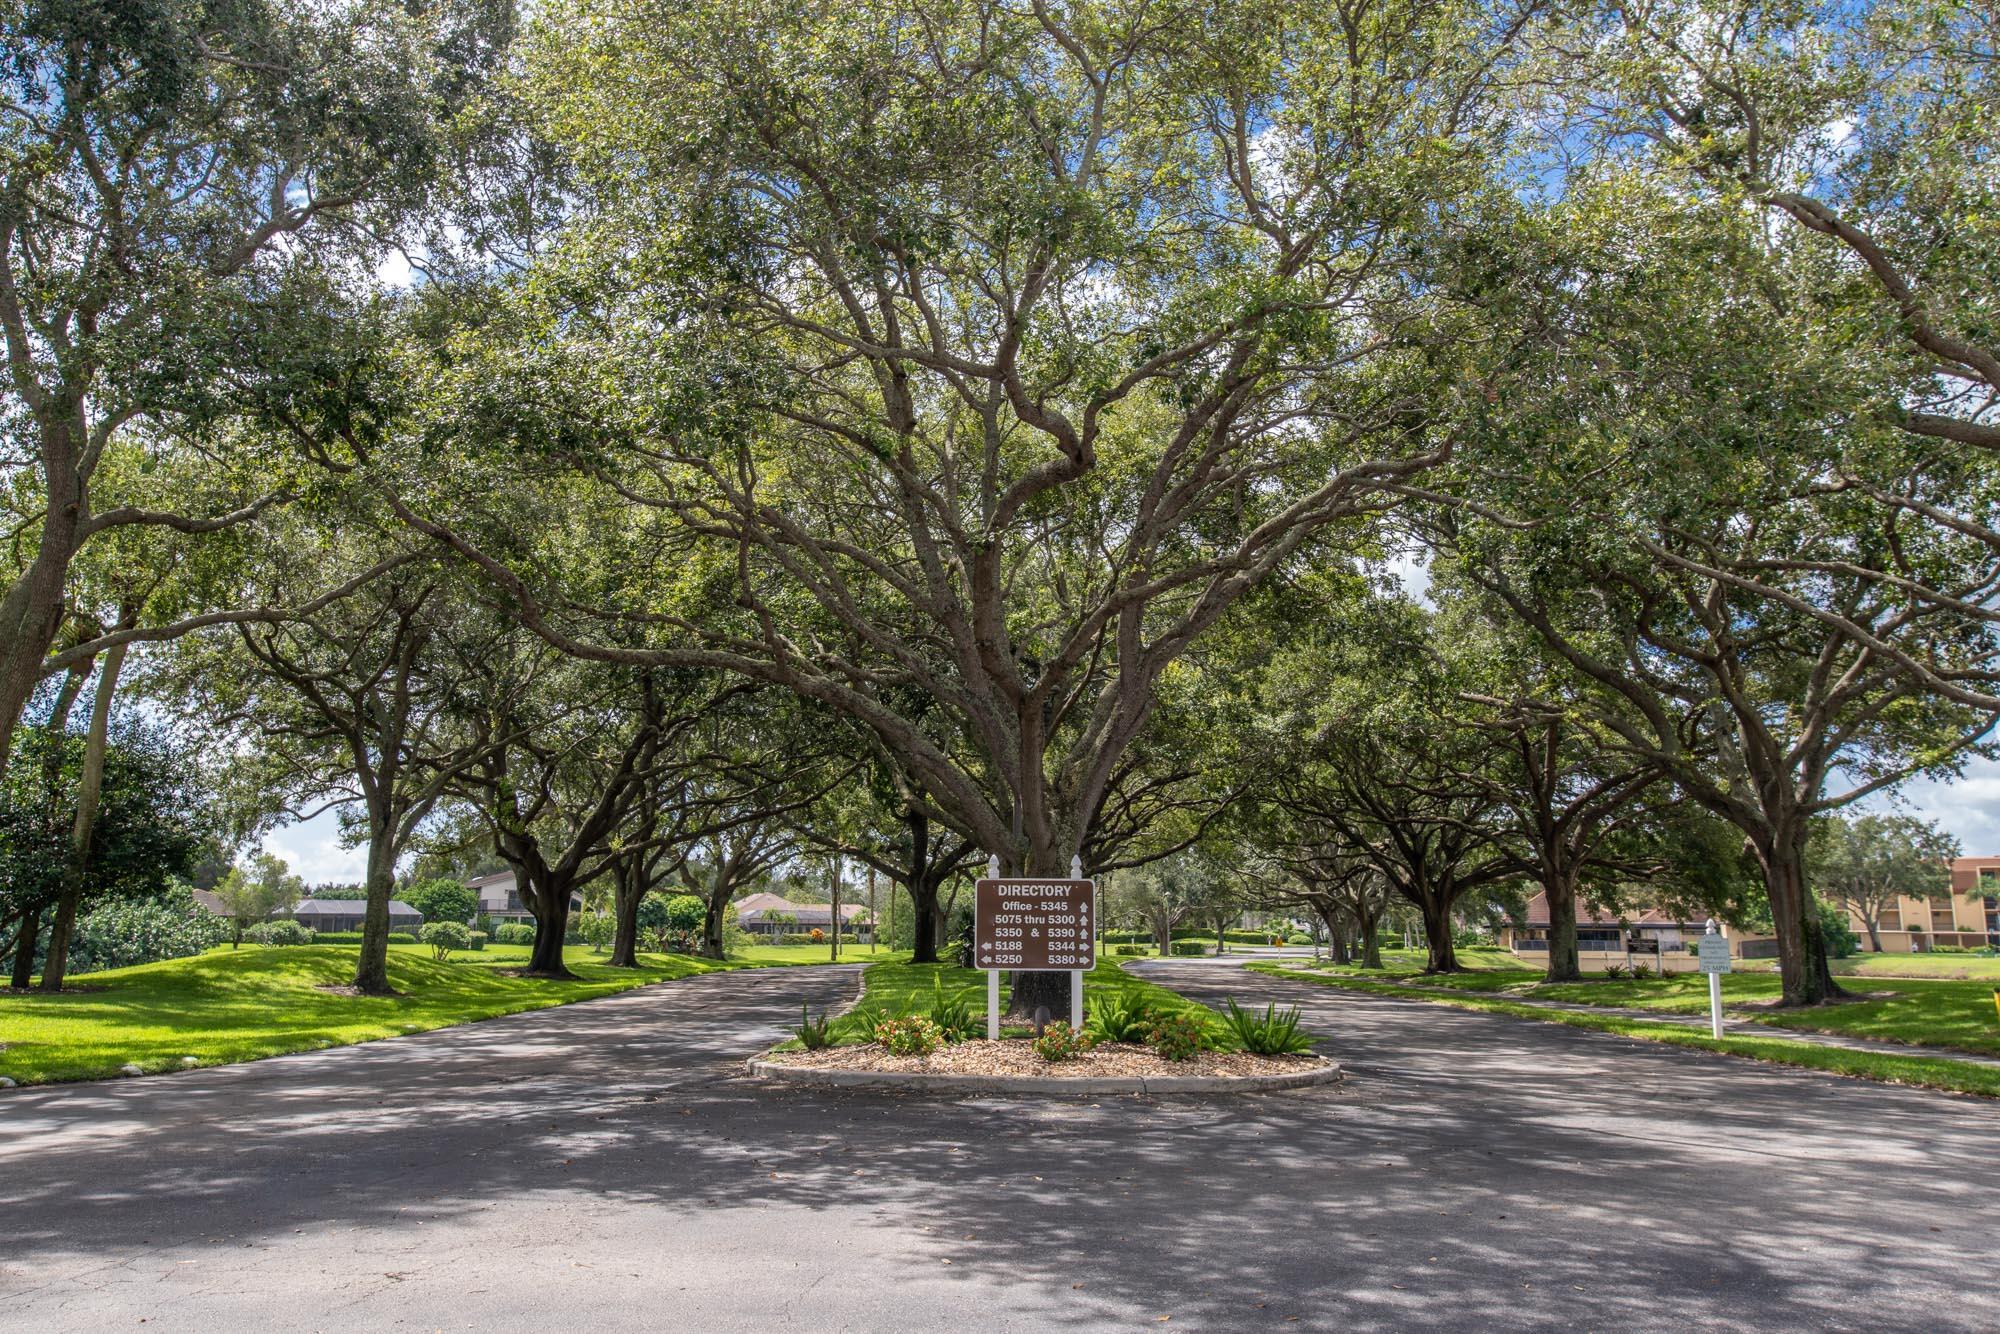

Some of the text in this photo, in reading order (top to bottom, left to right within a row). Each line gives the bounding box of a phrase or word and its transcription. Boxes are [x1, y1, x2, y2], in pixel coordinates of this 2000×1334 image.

[998, 885, 1072, 896] DIRECTORY
[1002, 901, 1032, 911] Office
[1040, 902, 1068, 911] 5345
[995, 915, 1075, 924] 5075 thru 5300
[995, 928, 1075, 937] 5350 & 5390
[995, 941, 1022, 951] 5188
[1048, 941, 1075, 951] 5344
[995, 954, 1022, 964] 5250
[1048, 954, 1075, 964] 5380
